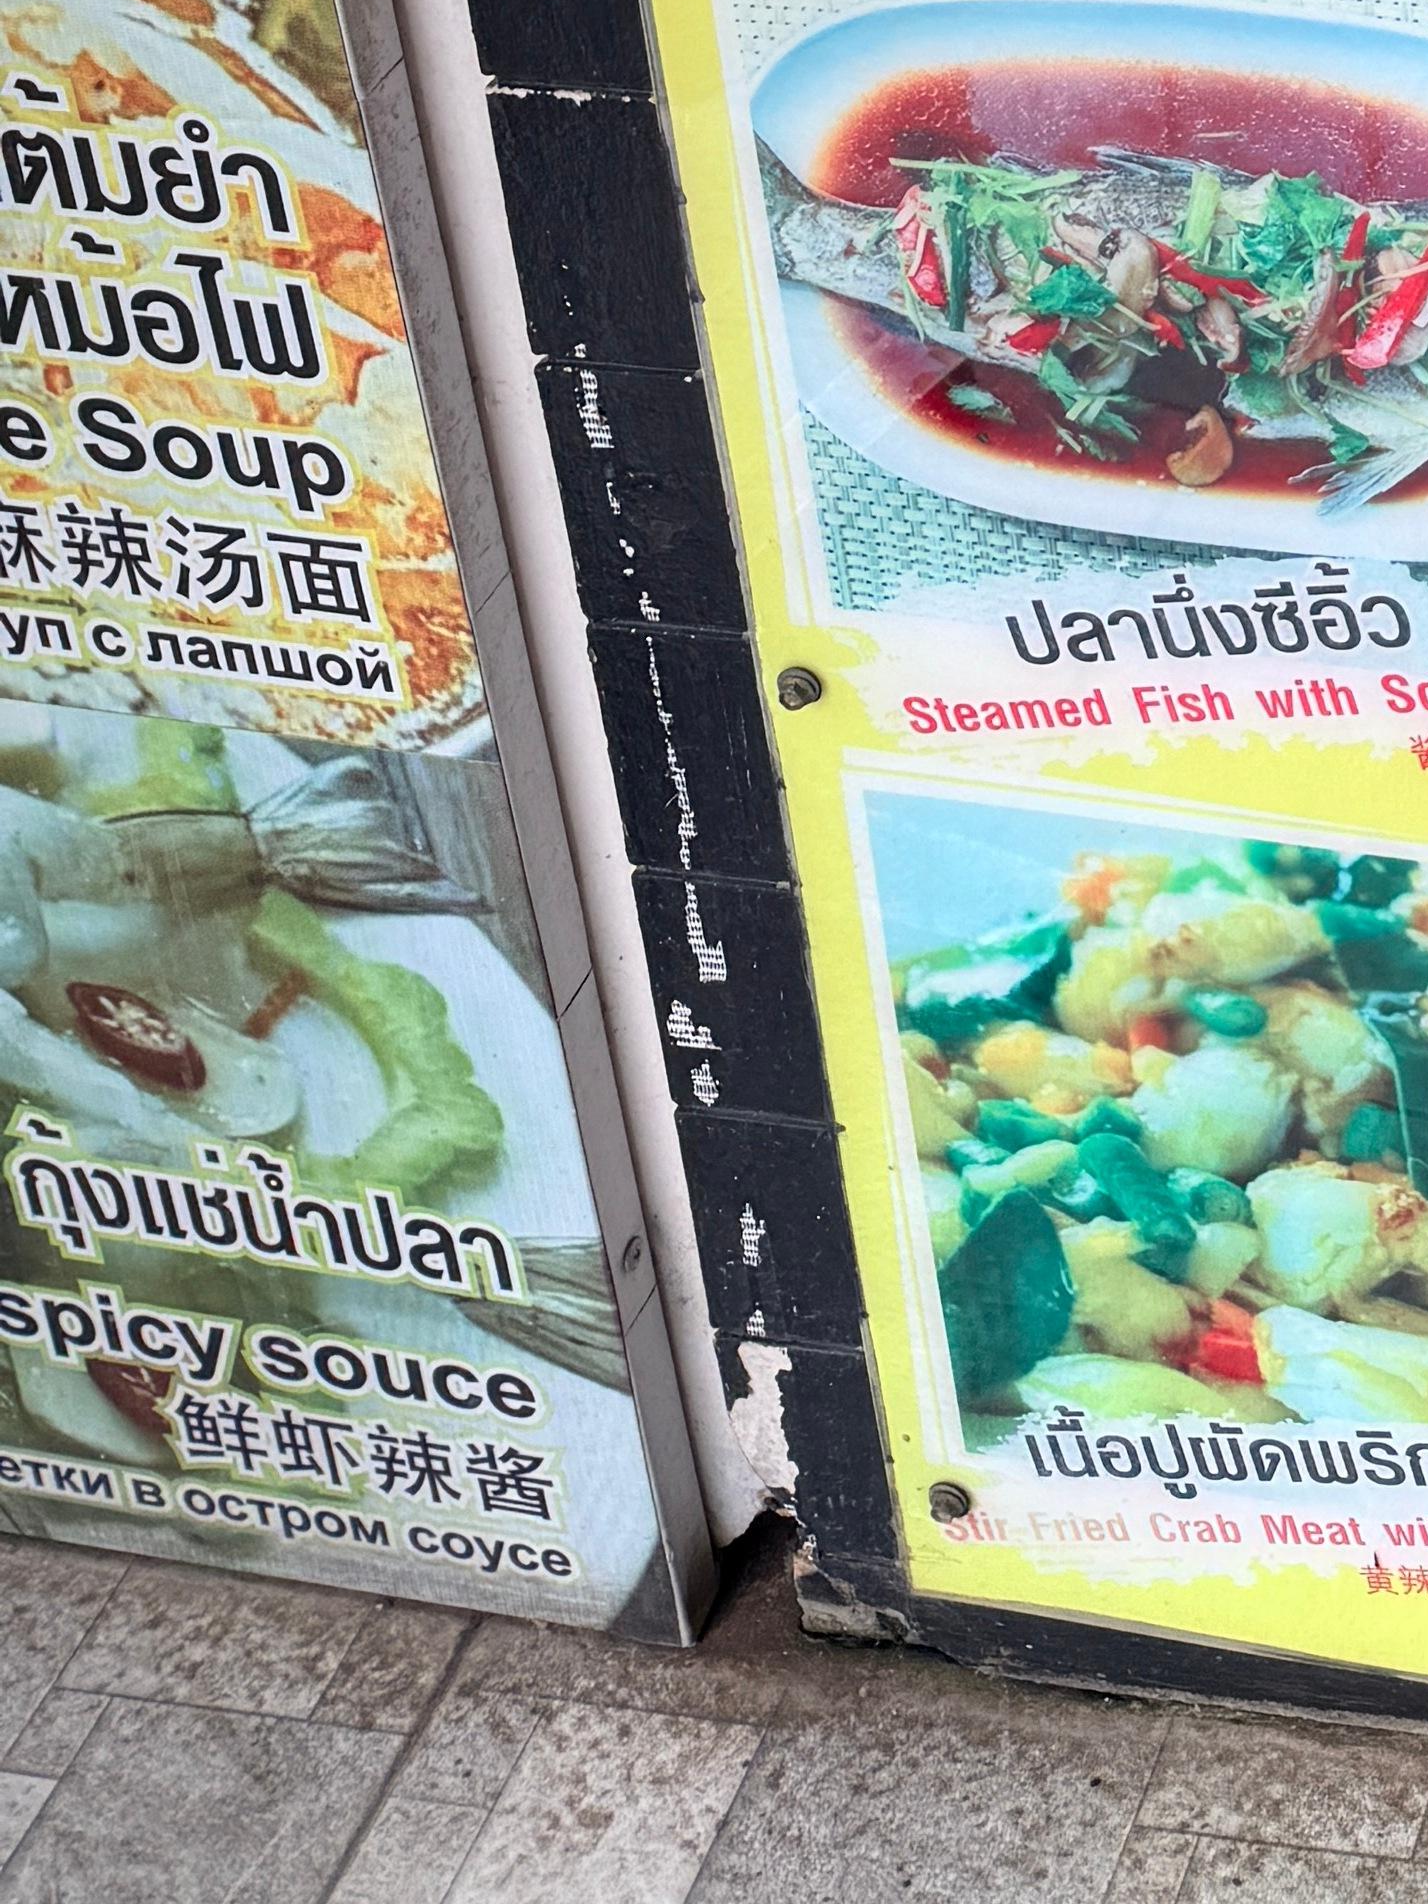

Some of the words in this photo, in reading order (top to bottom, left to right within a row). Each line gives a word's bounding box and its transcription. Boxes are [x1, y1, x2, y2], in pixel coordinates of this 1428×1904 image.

[1, 79, 289, 232] ต้มยำ
[78, 399, 345, 511] Soup
[148, 632, 393, 692] лапшой
[1006, 563, 1410, 664] ปลานึ่งซีอิ้ว
[903, 689, 1110, 734] Steamed
[1133, 685, 1233, 724] Fish
[1256, 679, 1358, 718] with
[19, 1118, 514, 1293] กุ้งแช่น้ำปลา
[0, 1295, 228, 1381] spicy
[256, 1334, 537, 1419] souce
[175, 1394, 555, 1521] 鲜虾辣酱
[185, 1489, 391, 1547] остром
[410, 1527, 571, 1575] соусе
[1024, 1511, 1132, 1543] Fried
[1150, 1512, 1242, 1545] Crab
[1260, 1512, 1366, 1546] Meat
